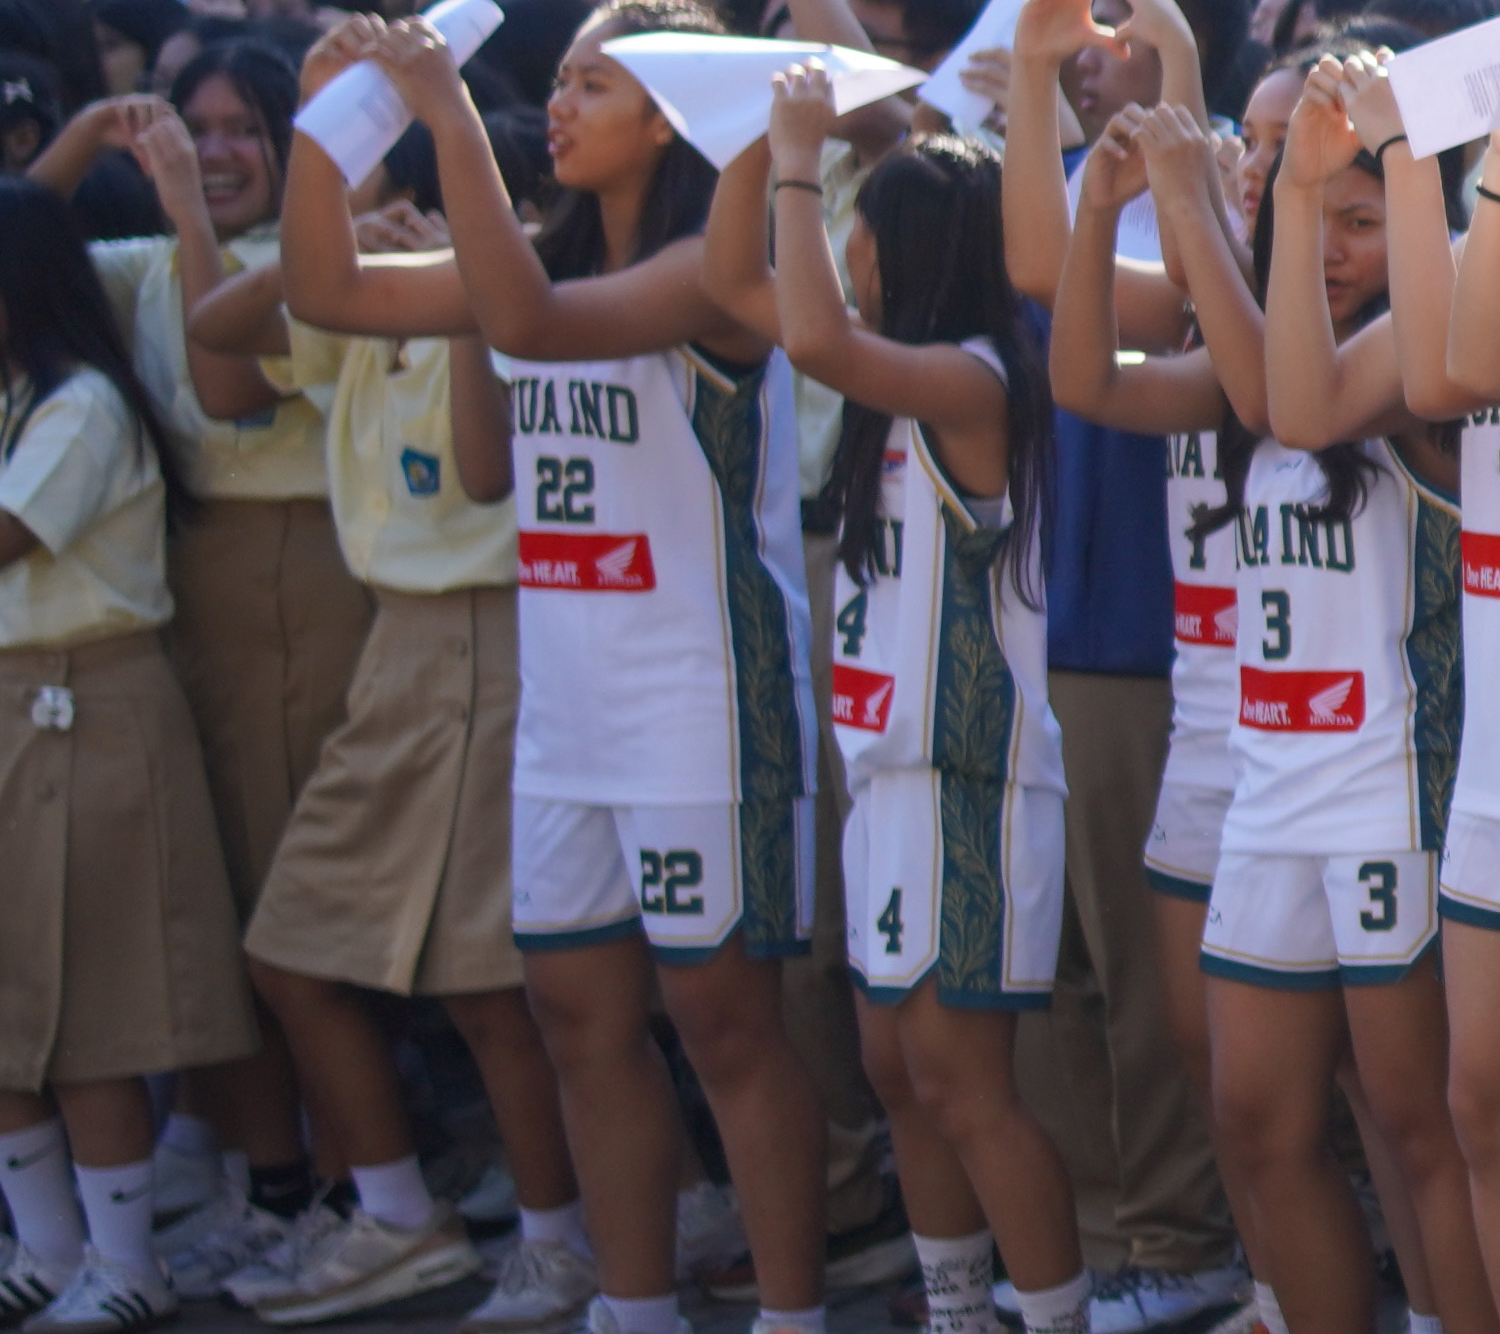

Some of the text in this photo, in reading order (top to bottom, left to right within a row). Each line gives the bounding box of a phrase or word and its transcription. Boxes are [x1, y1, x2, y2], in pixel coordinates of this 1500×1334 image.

[511, 377, 640, 446] UA IND
[536, 455, 596, 524] 22
[1279, 503, 1355, 574] IND
[837, 588, 867, 657] 4
[1261, 588, 1292, 661] 3
[640, 848, 705, 915] 22
[1357, 861, 1398, 932] 3
[877, 887, 904, 955] 4
